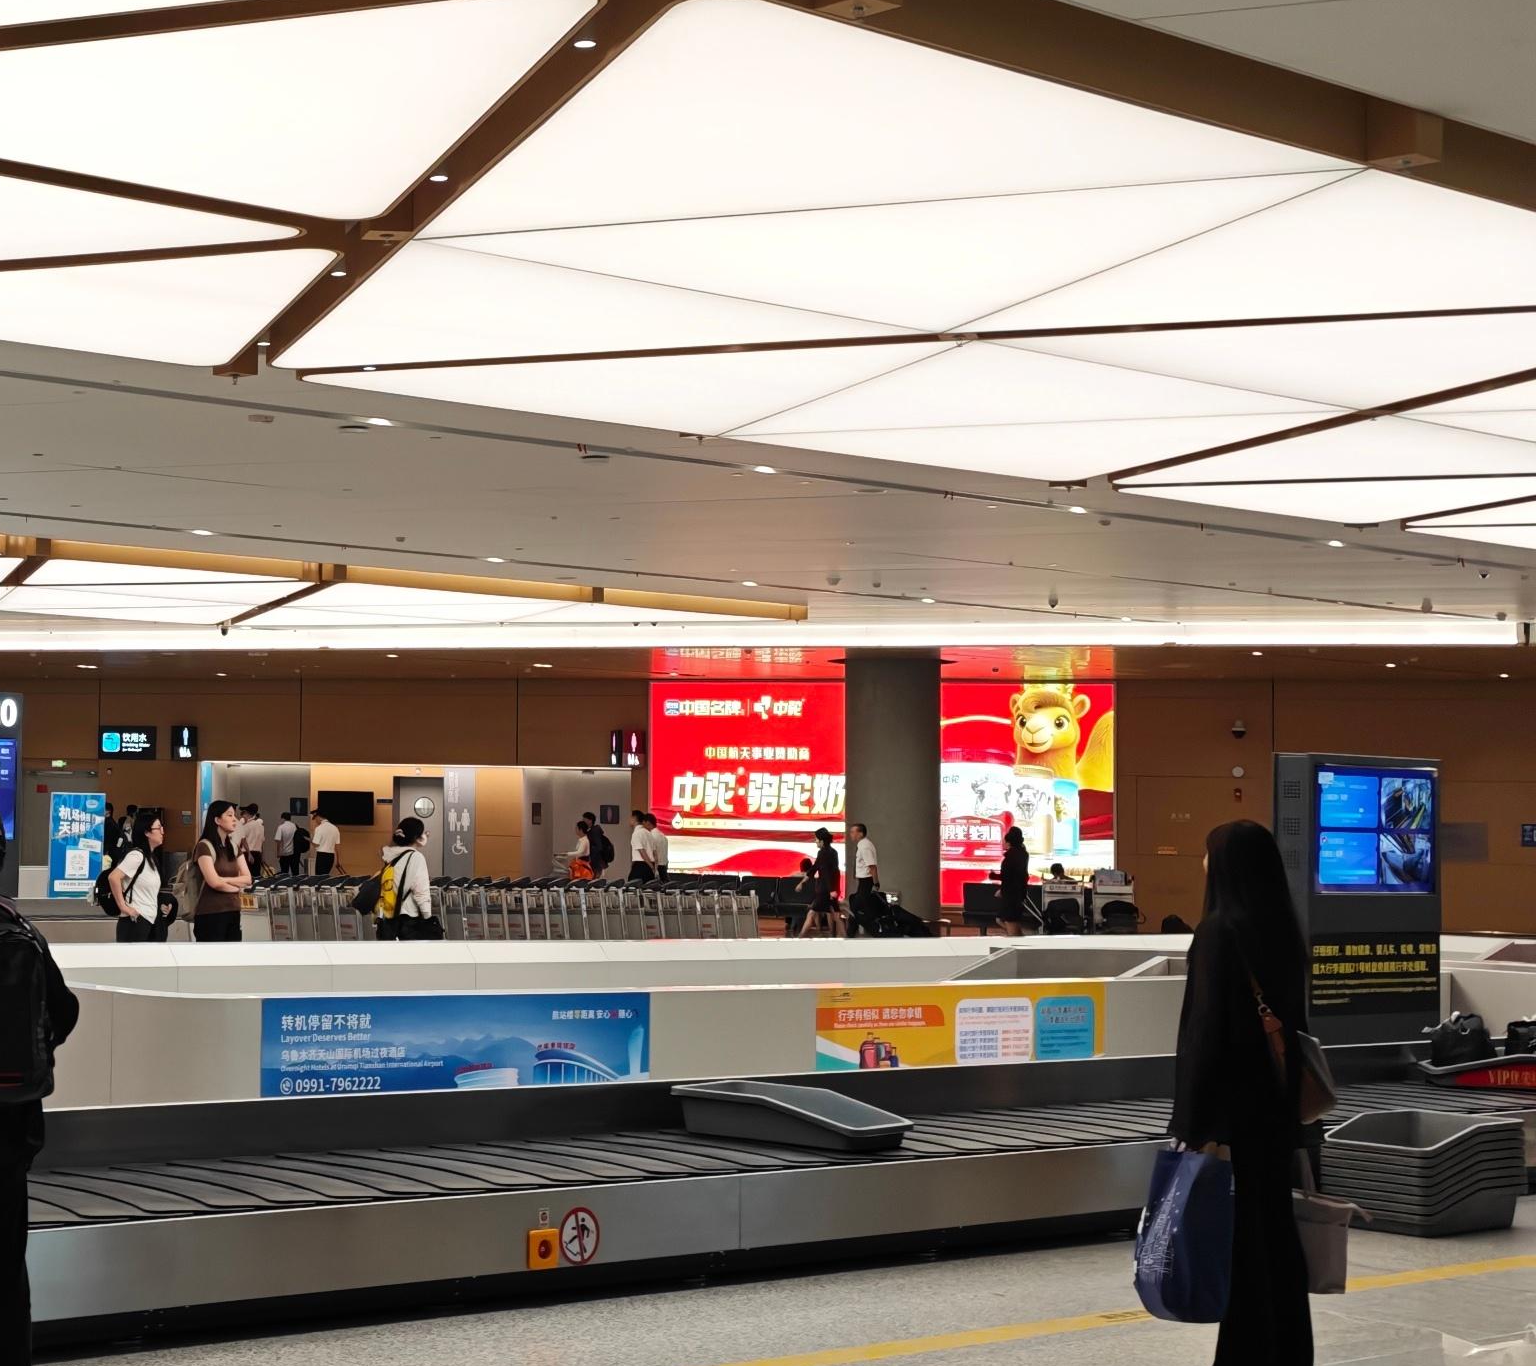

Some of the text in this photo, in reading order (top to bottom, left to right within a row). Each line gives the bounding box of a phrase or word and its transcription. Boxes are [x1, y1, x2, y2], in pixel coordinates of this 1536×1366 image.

[680, 699, 743, 716] 中国名牌
[122, 732, 147, 742] 饮用水
[281, 1013, 372, 1031] 转机停留不将就
[281, 1032, 372, 1045] Layover Deserves Better
[295, 1076, 381, 1093] 0991-7962222
